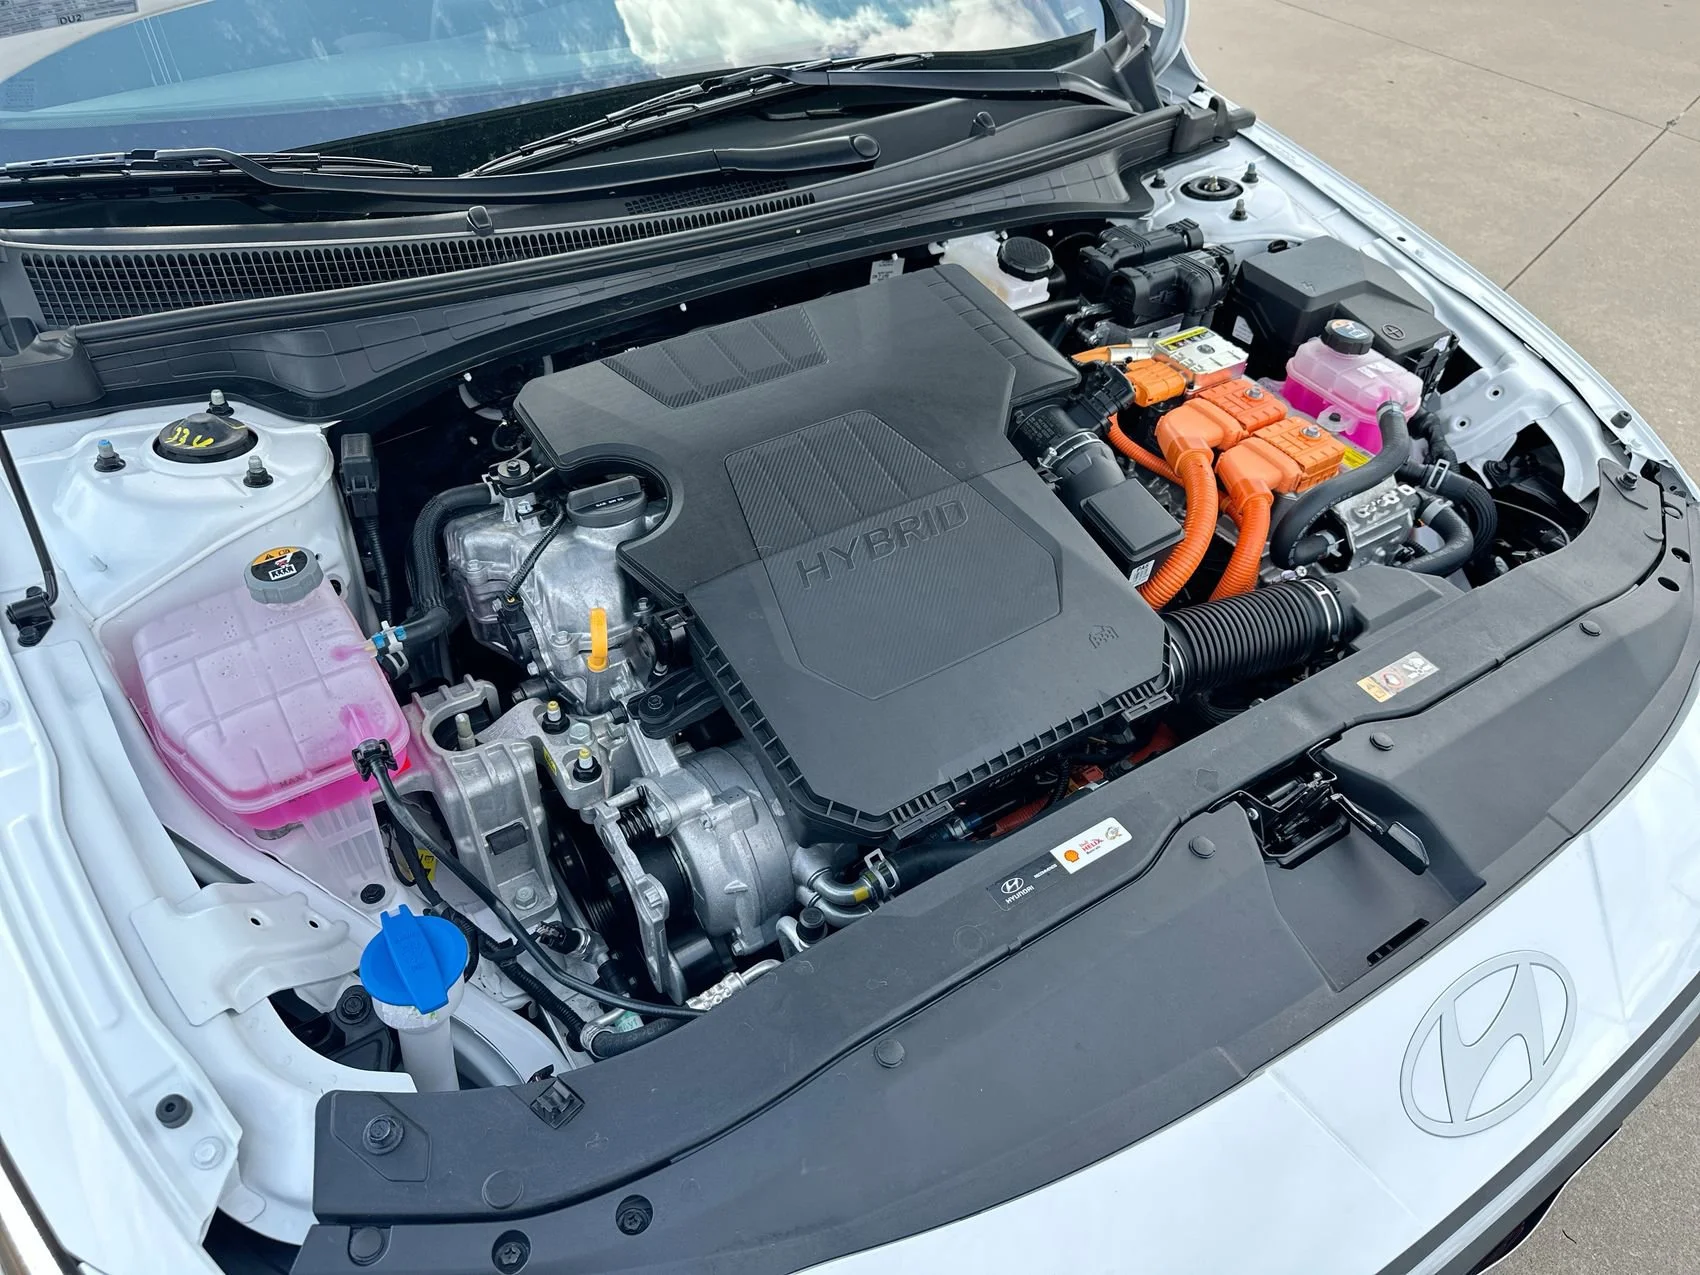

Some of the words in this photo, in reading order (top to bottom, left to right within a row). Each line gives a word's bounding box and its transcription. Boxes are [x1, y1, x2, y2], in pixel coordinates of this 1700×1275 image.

[59, 14, 82, 25] DU2
[796, 500, 969, 590] HYBRID
[1004, 884, 1035, 904] HYUNDAI
